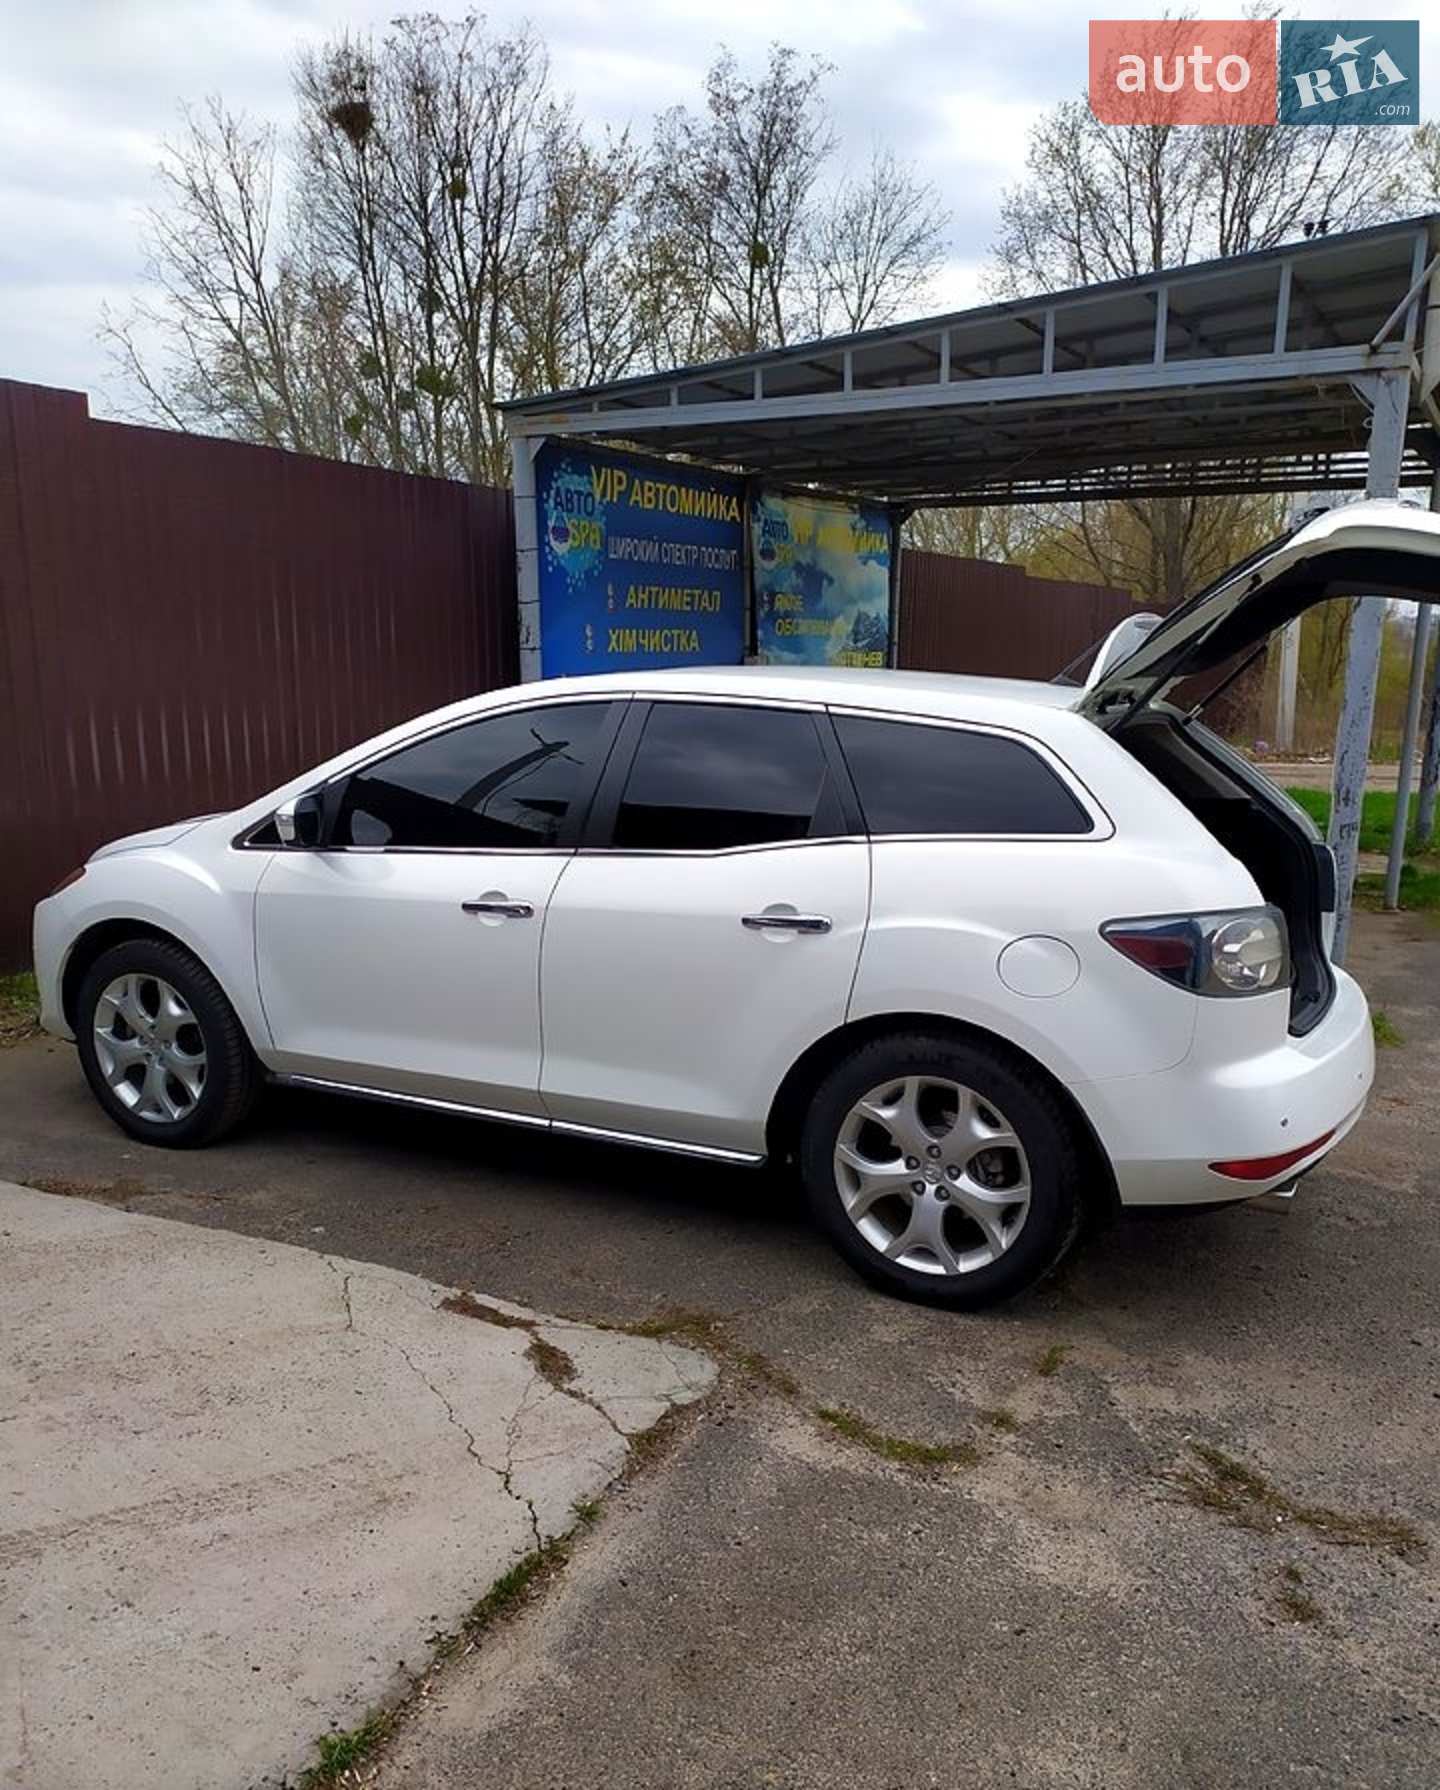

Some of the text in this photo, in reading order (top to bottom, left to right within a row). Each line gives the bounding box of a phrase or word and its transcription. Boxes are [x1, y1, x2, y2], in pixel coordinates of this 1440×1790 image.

[553, 486, 596, 517] АВТО
[591, 465, 741, 523] VIP АВТОМИЙКА
[608, 535, 661, 564] ШИРОКИЙ
[661, 541, 698, 568] СПЕКТР
[625, 585, 722, 613] АНТИМЕТАЛ
[607, 629, 701, 653] ХІМЧИСТКА
